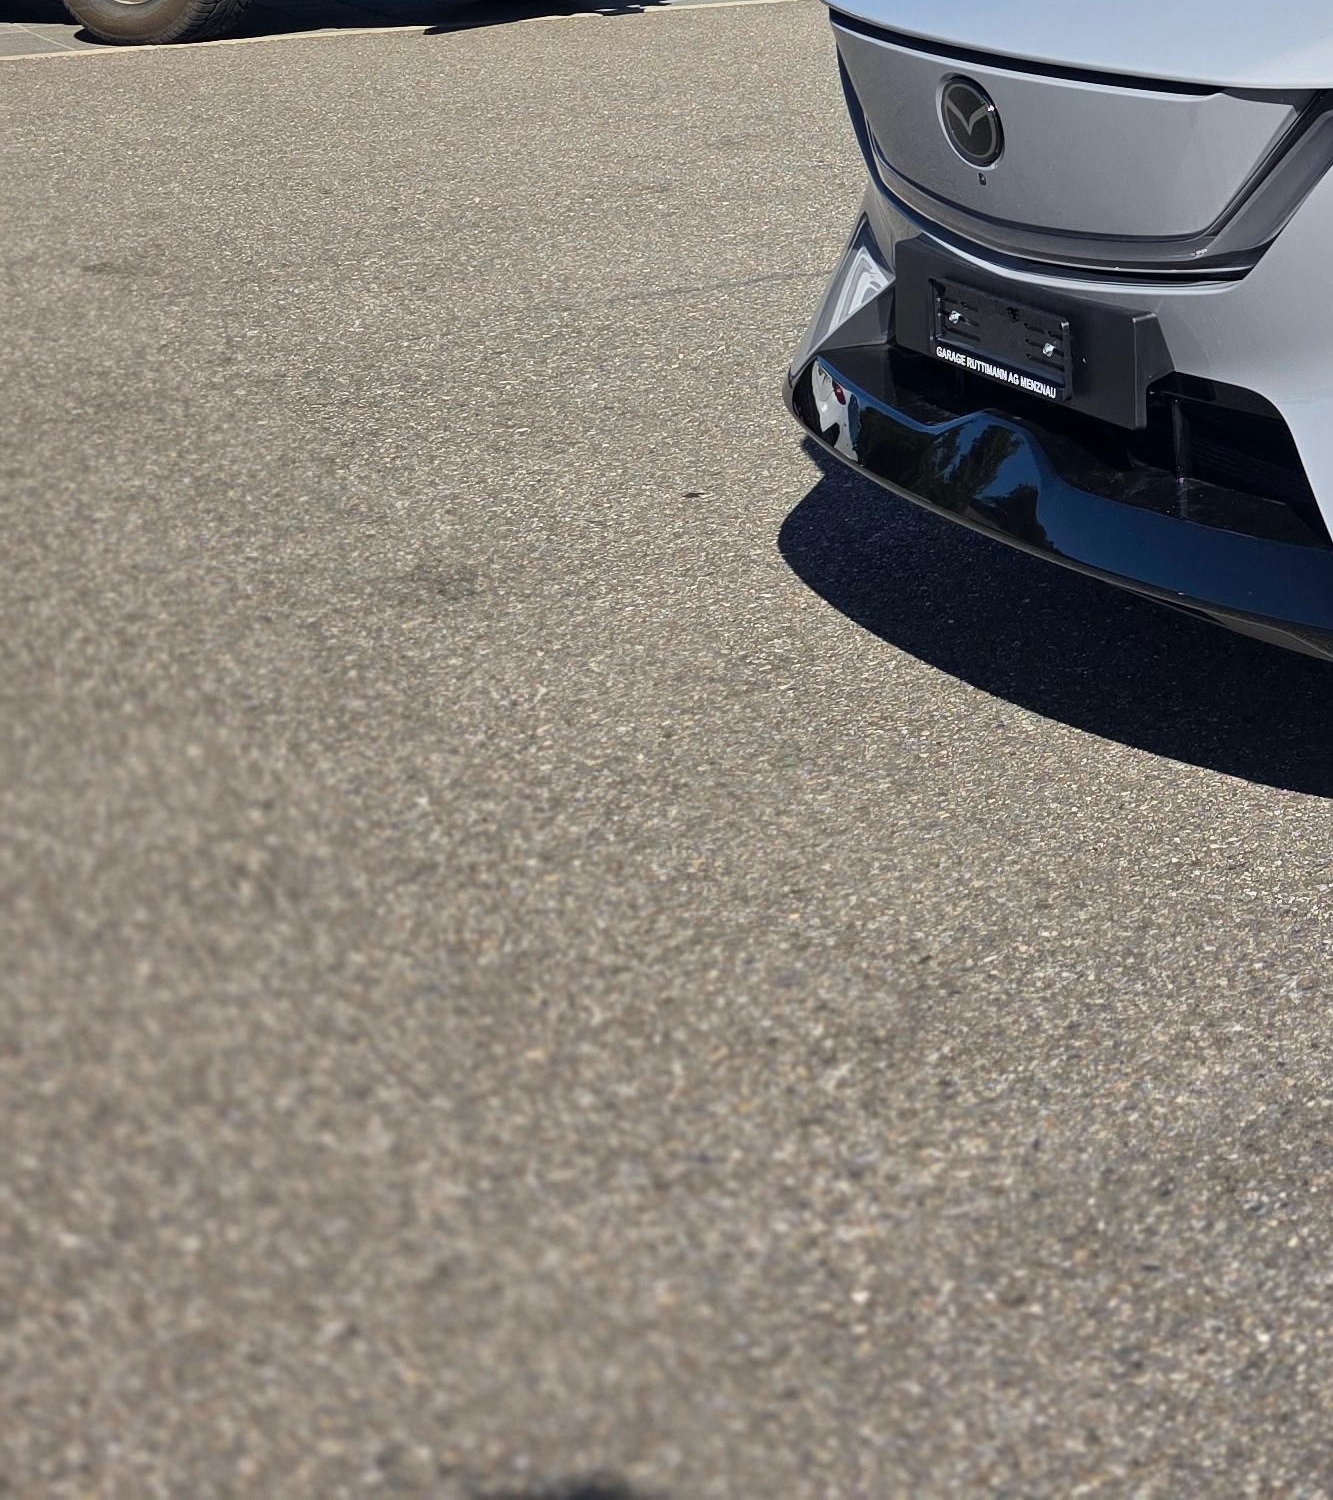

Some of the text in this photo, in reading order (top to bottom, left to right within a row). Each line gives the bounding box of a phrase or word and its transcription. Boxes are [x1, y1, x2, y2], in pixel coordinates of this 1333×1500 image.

[936, 346, 967, 366] GARAGE
[1008, 371, 1020, 385] AG
[1020, 375, 1057, 399] MENZNAU
